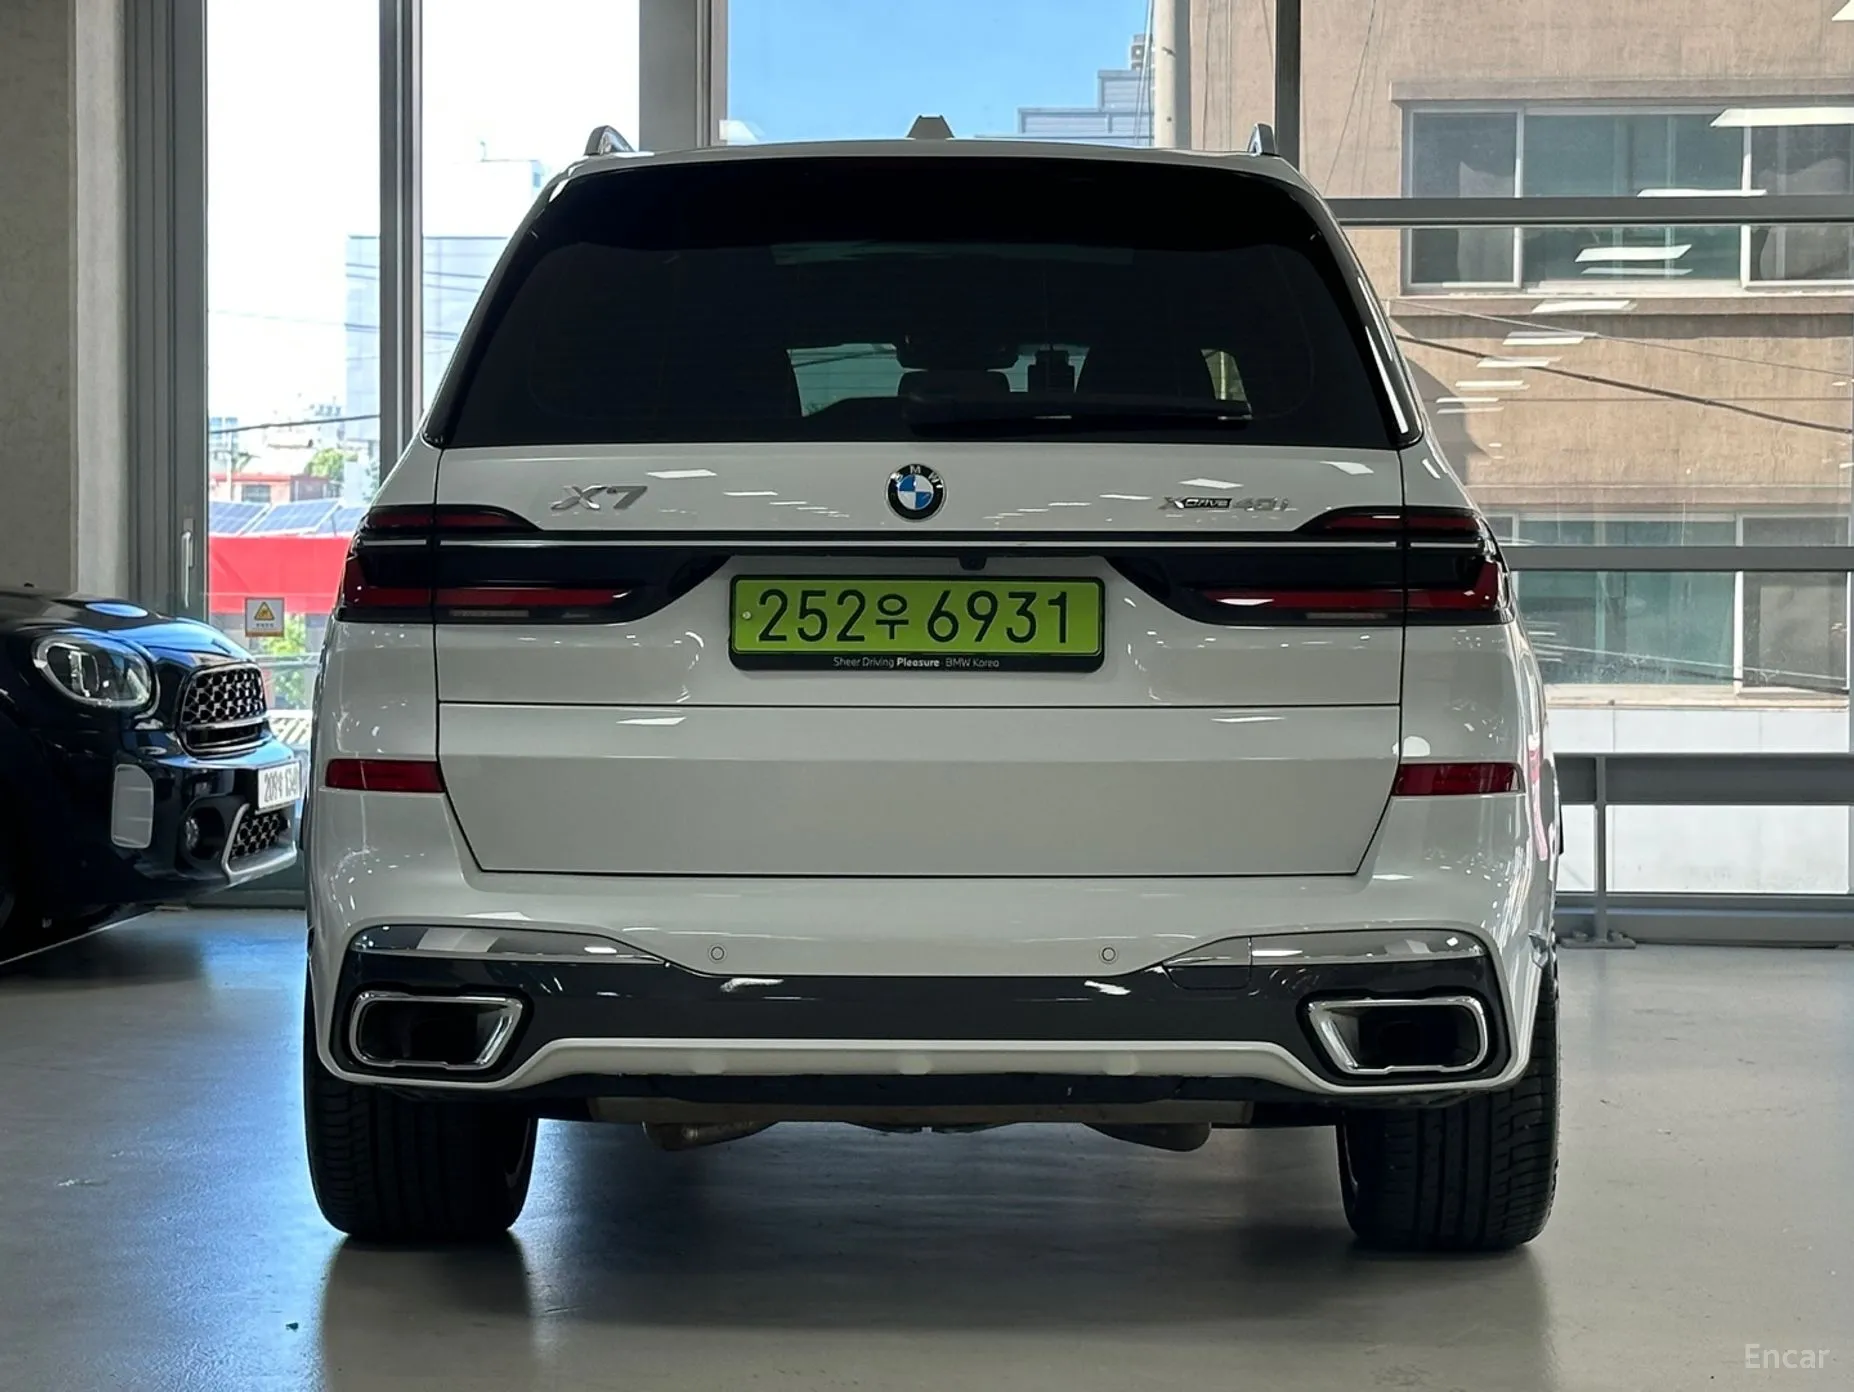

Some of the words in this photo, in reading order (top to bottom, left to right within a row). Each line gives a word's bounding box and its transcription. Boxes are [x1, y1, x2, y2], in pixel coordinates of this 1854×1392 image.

[550, 484, 648, 511] X7
[757, 588, 909, 643] 252우
[926, 589, 1068, 644] 6931
[833, 657, 861, 667] Sheer
[862, 657, 895, 669] Driving
[896, 657, 940, 668] Pleasure
[945, 658, 970, 668] BMW
[972, 658, 1000, 668] Korea
